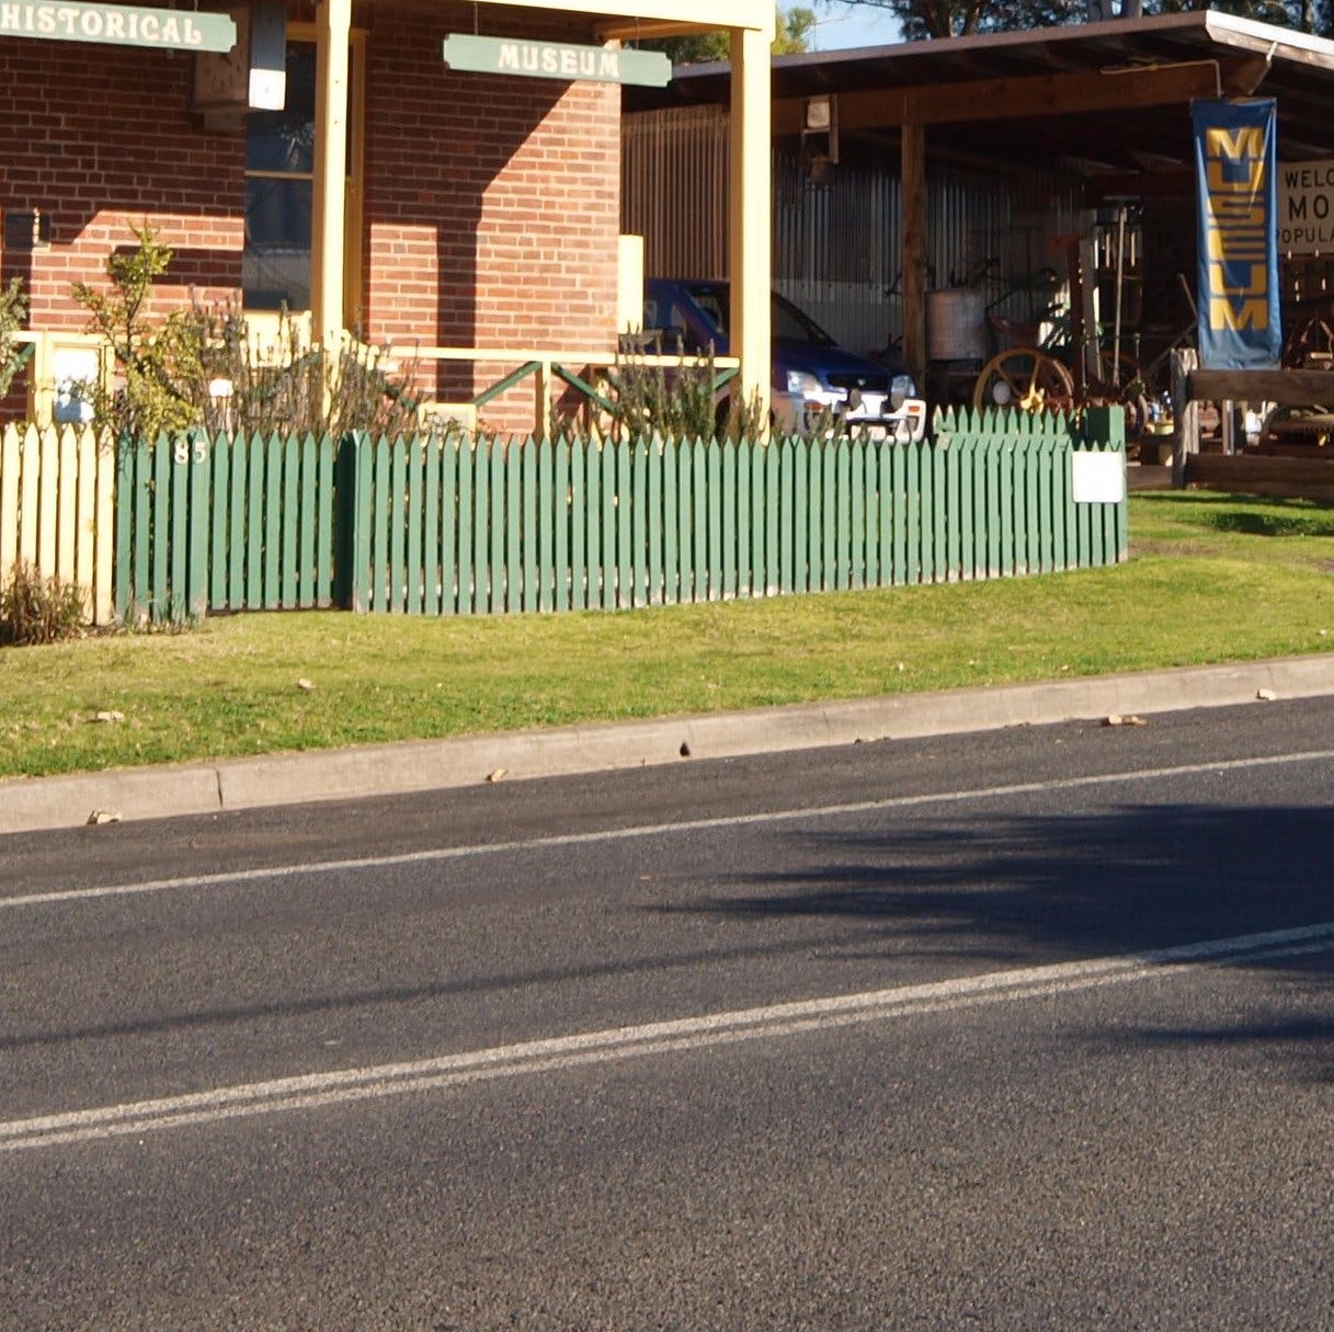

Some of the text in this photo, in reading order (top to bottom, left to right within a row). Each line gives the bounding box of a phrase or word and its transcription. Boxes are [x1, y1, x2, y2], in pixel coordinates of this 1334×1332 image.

[1, 3, 202, 44] HISTORICAL
[497, 43, 619, 78] MUSEUM
[1205, 126, 1268, 331] MUSEUM
[174, 439, 206, 465] 85
